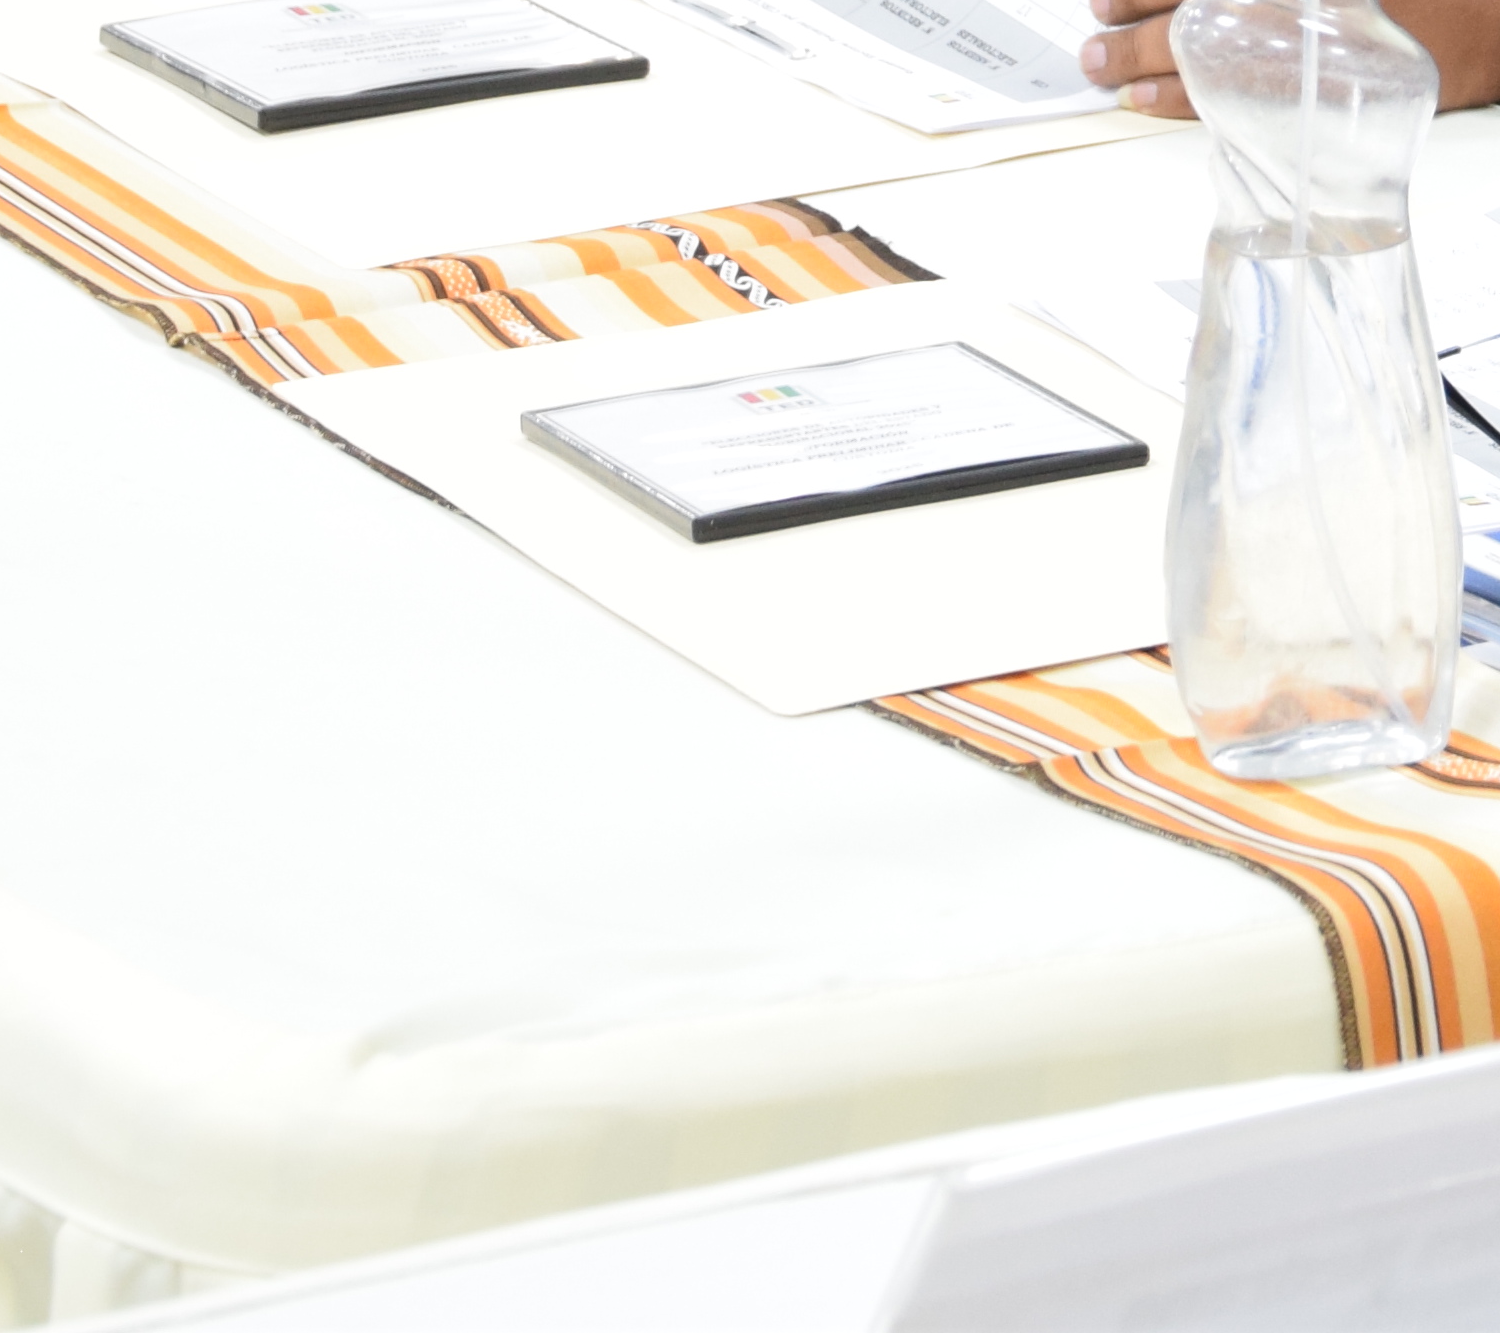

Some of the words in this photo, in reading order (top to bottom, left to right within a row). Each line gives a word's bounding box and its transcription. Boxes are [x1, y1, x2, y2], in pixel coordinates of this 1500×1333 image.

[880, 0, 923, 28] RECINTOS
[1016, 4, 1032, 17] 17
[957, 29, 1018, 67] ELECTORALES
[757, 398, 815, 412] TED
